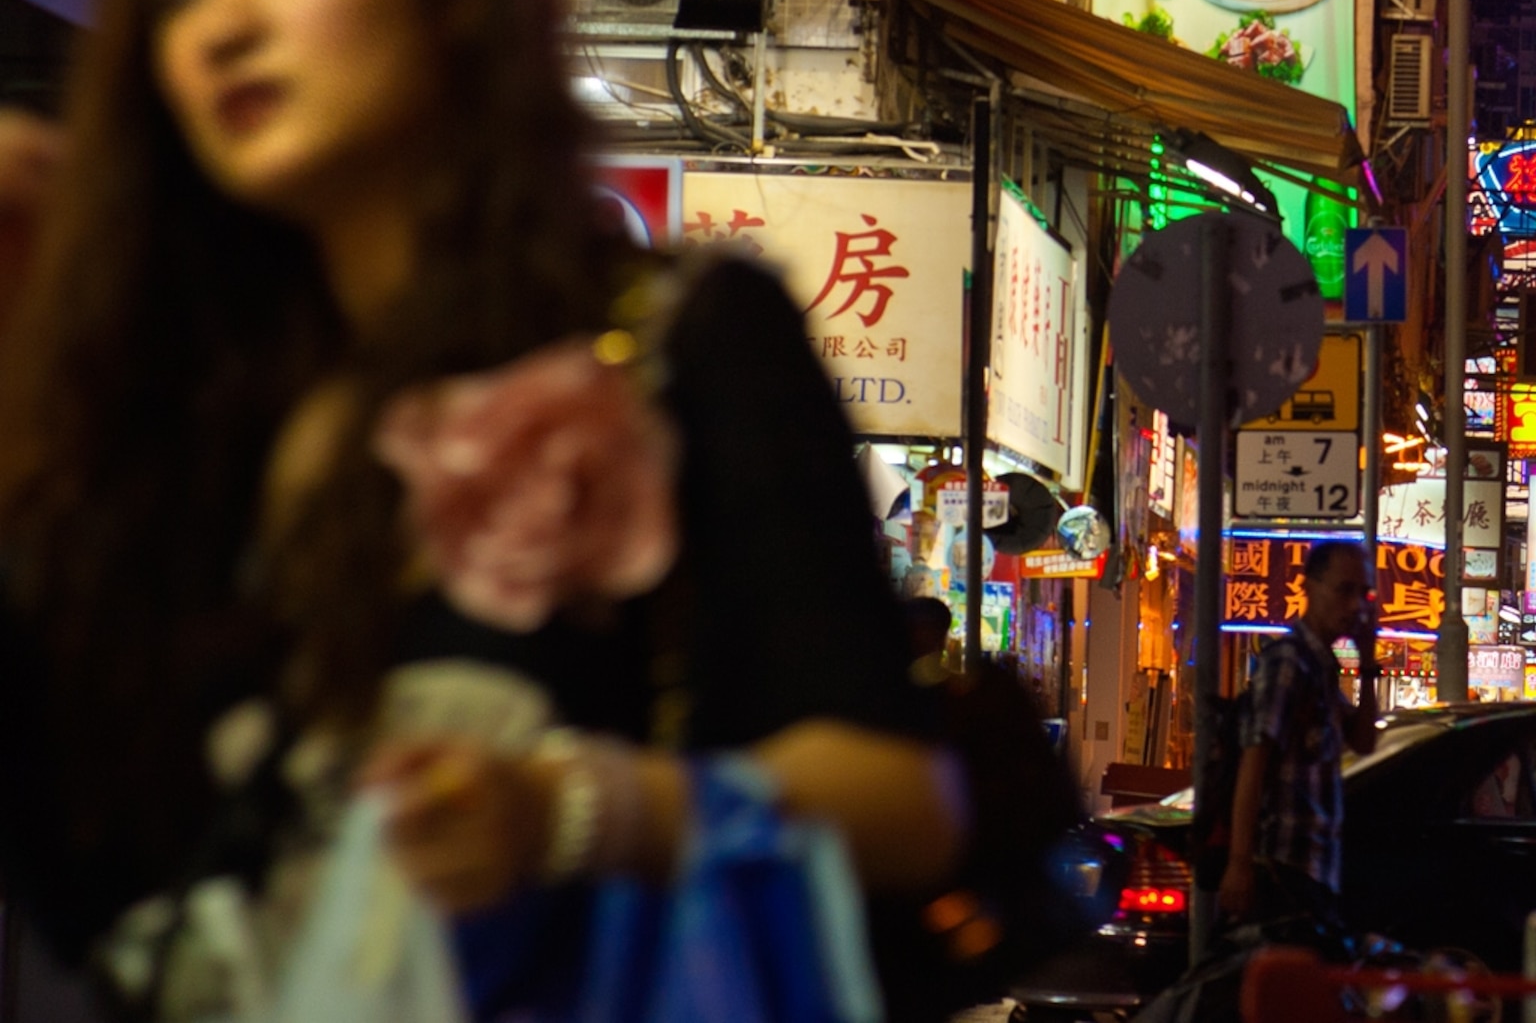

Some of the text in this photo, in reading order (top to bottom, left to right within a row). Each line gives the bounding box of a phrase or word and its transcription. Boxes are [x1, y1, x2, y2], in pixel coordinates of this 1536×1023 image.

[1258, 450, 1291, 465] 上午
[1264, 435, 1332, 464] am 7
[1242, 480, 1348, 510] midnight 12
[1257, 496, 1290, 511] 午夜
[1413, 499, 1489, 529] 茶廳
